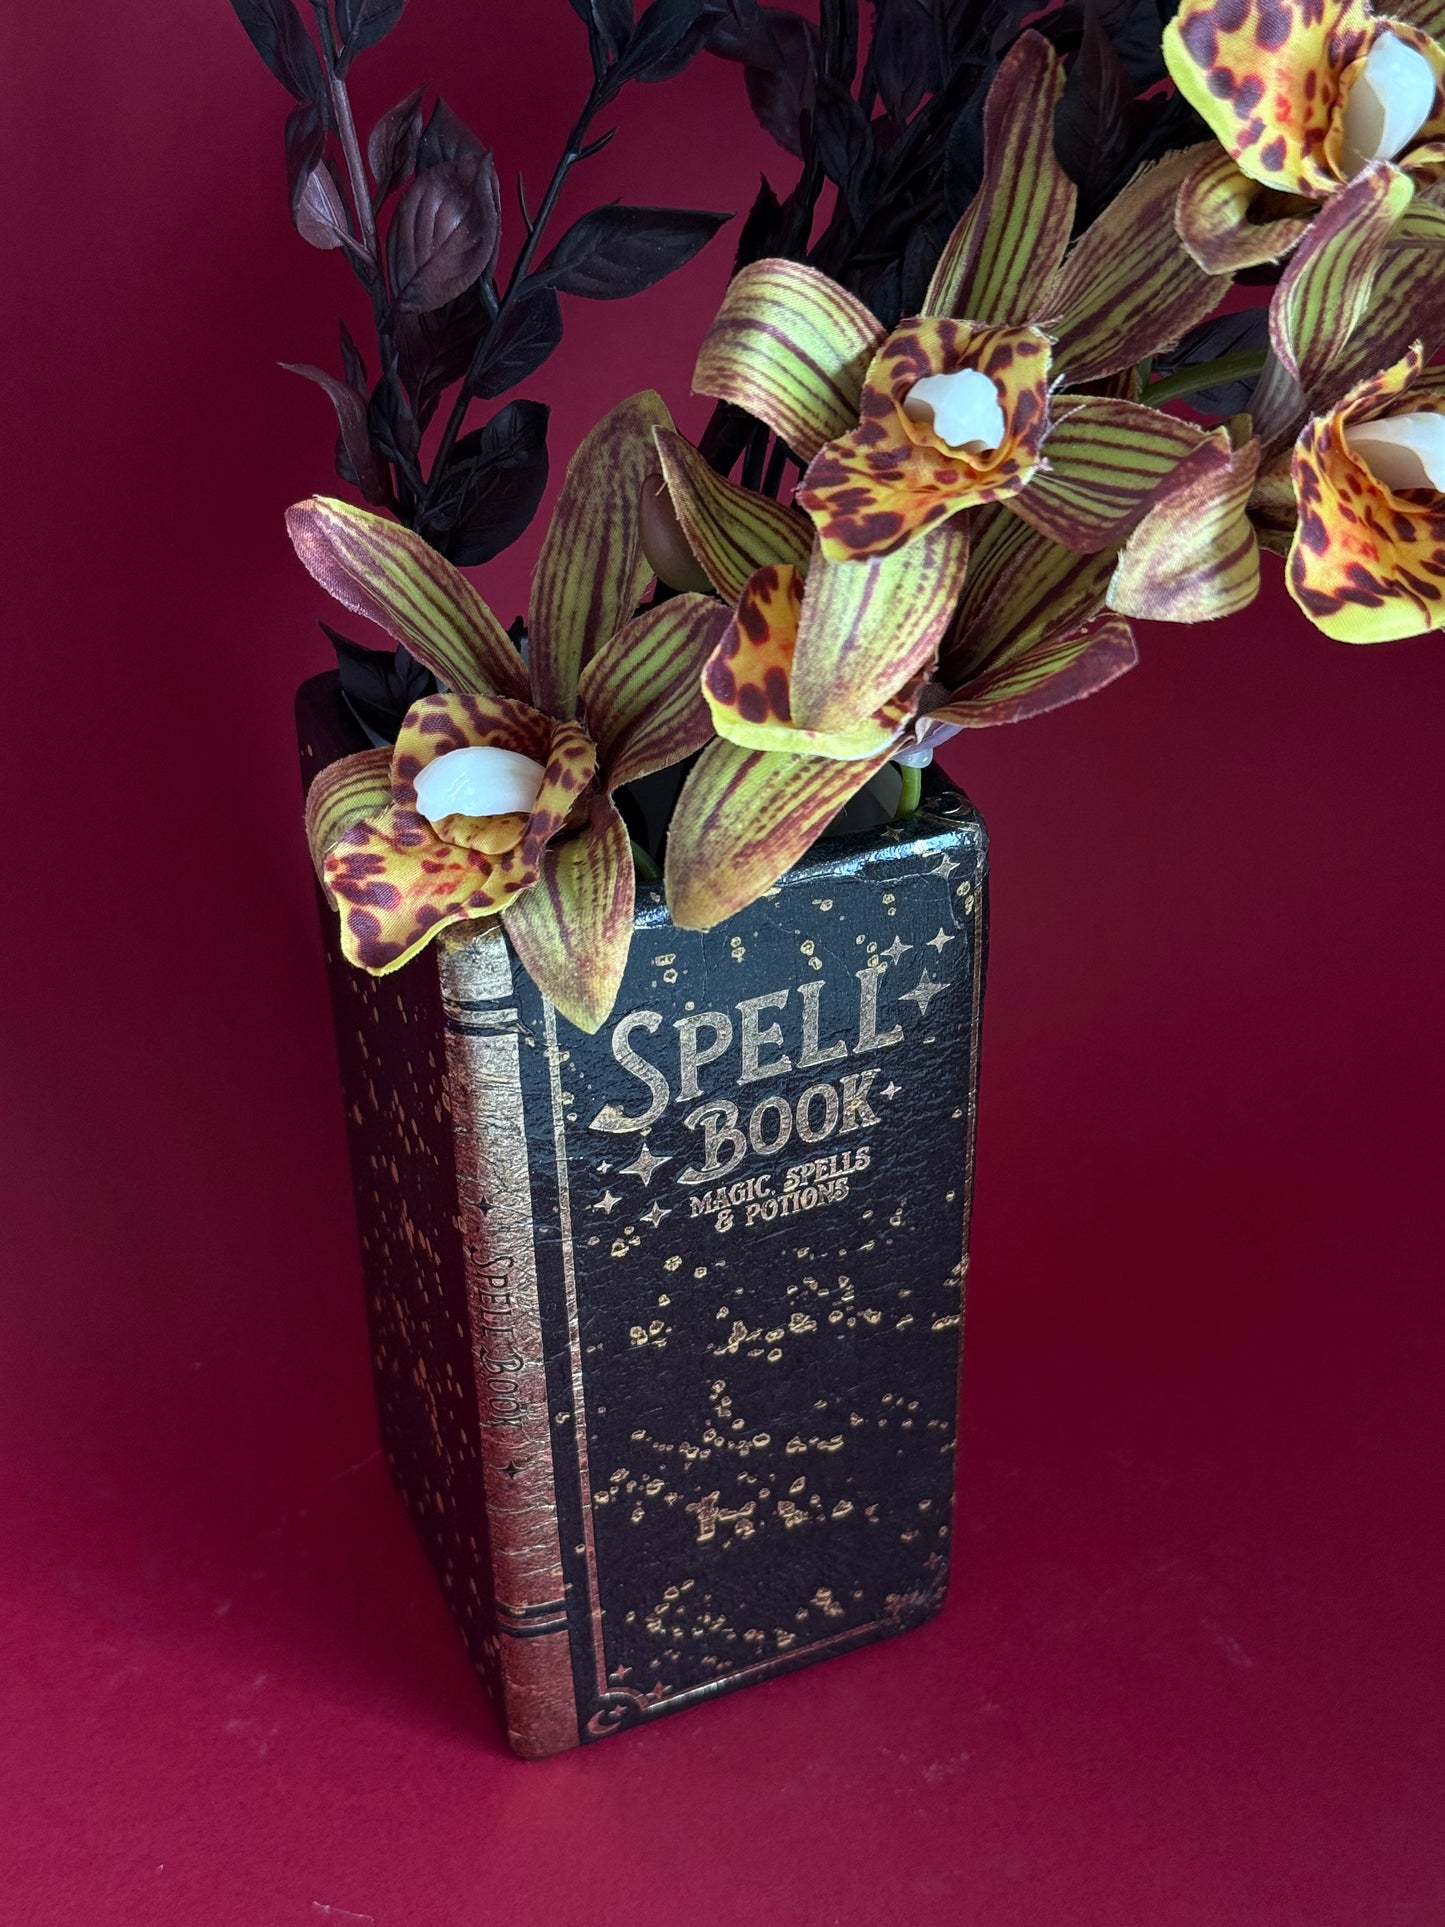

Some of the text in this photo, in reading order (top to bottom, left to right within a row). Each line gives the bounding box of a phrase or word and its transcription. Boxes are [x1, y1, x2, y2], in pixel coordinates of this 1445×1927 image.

[588, 967, 904, 1134] SPELL
[676, 1068, 882, 1185] BOOK
[783, 1146, 871, 1193] SPELLS
[714, 1177, 850, 1233] & POTIONS
[469, 1245, 525, 1429] SPELL BOOK
